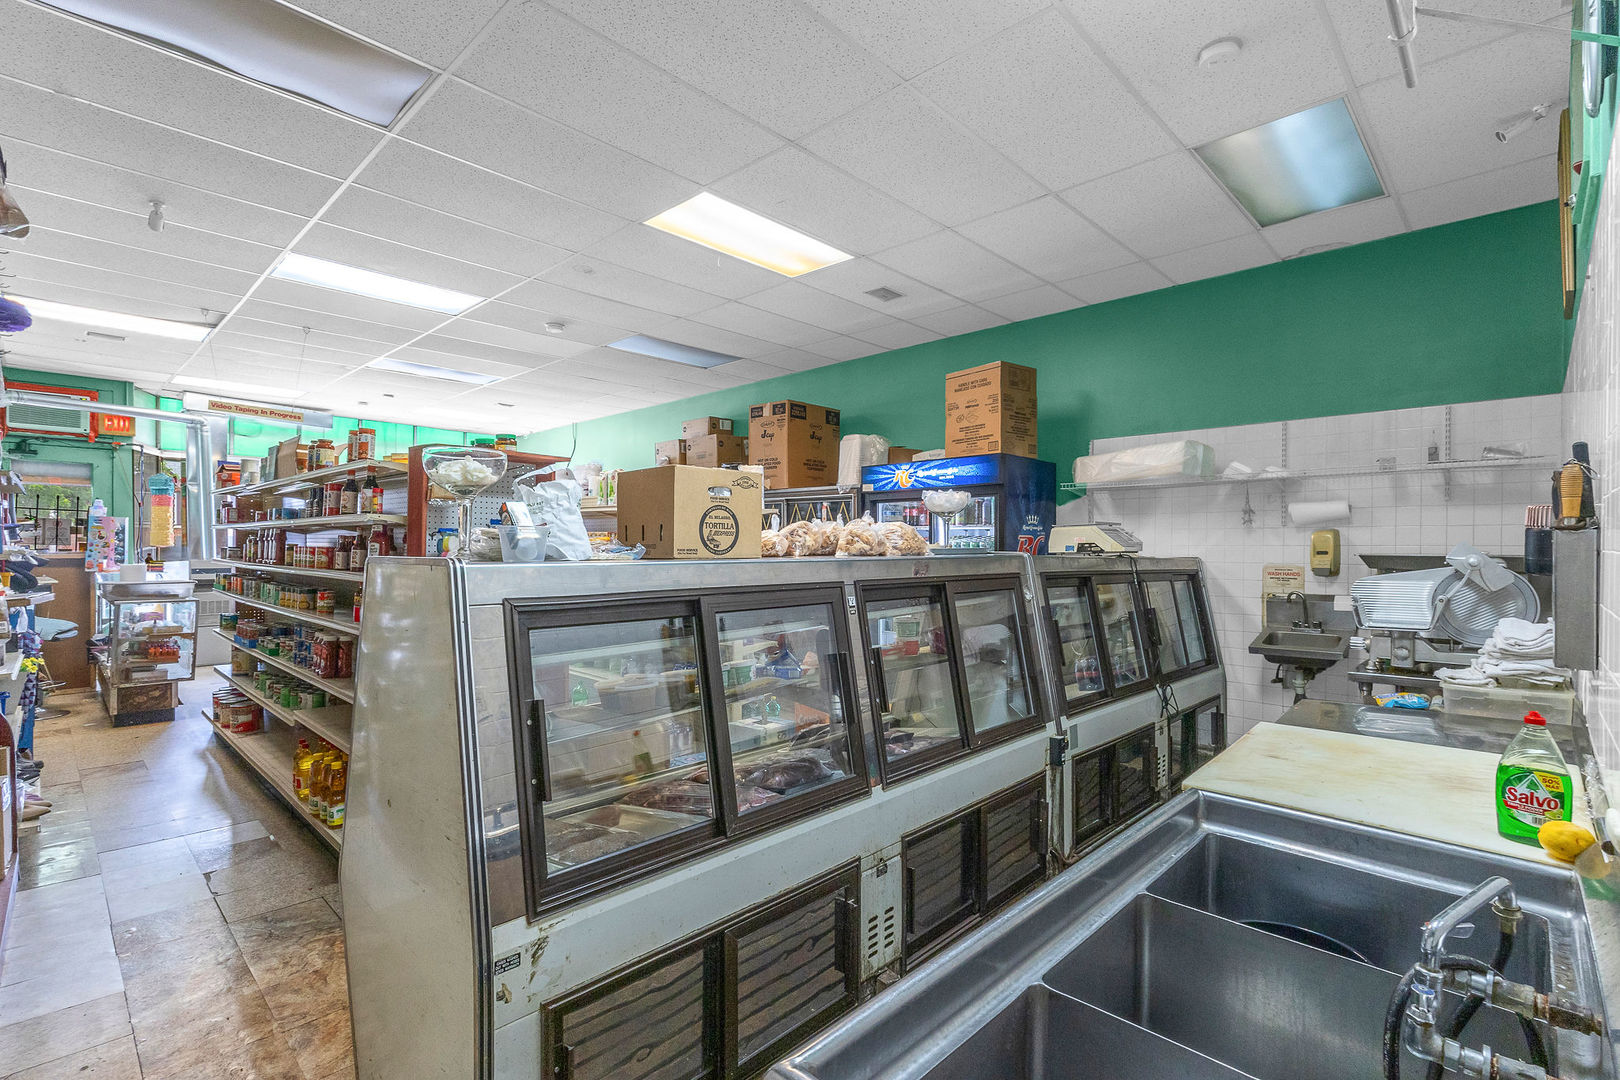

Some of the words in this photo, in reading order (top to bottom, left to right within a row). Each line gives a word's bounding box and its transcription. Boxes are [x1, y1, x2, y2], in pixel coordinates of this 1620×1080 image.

[210, 401, 233, 410] Video
[234, 405, 259, 415] Taping
[269, 410, 302, 420] Progress
[104, 416, 130, 432] EXIT
[893, 469, 916, 488] RC
[705, 522, 734, 530] TORTILLA
[1506, 786, 1559, 810] Salvo
